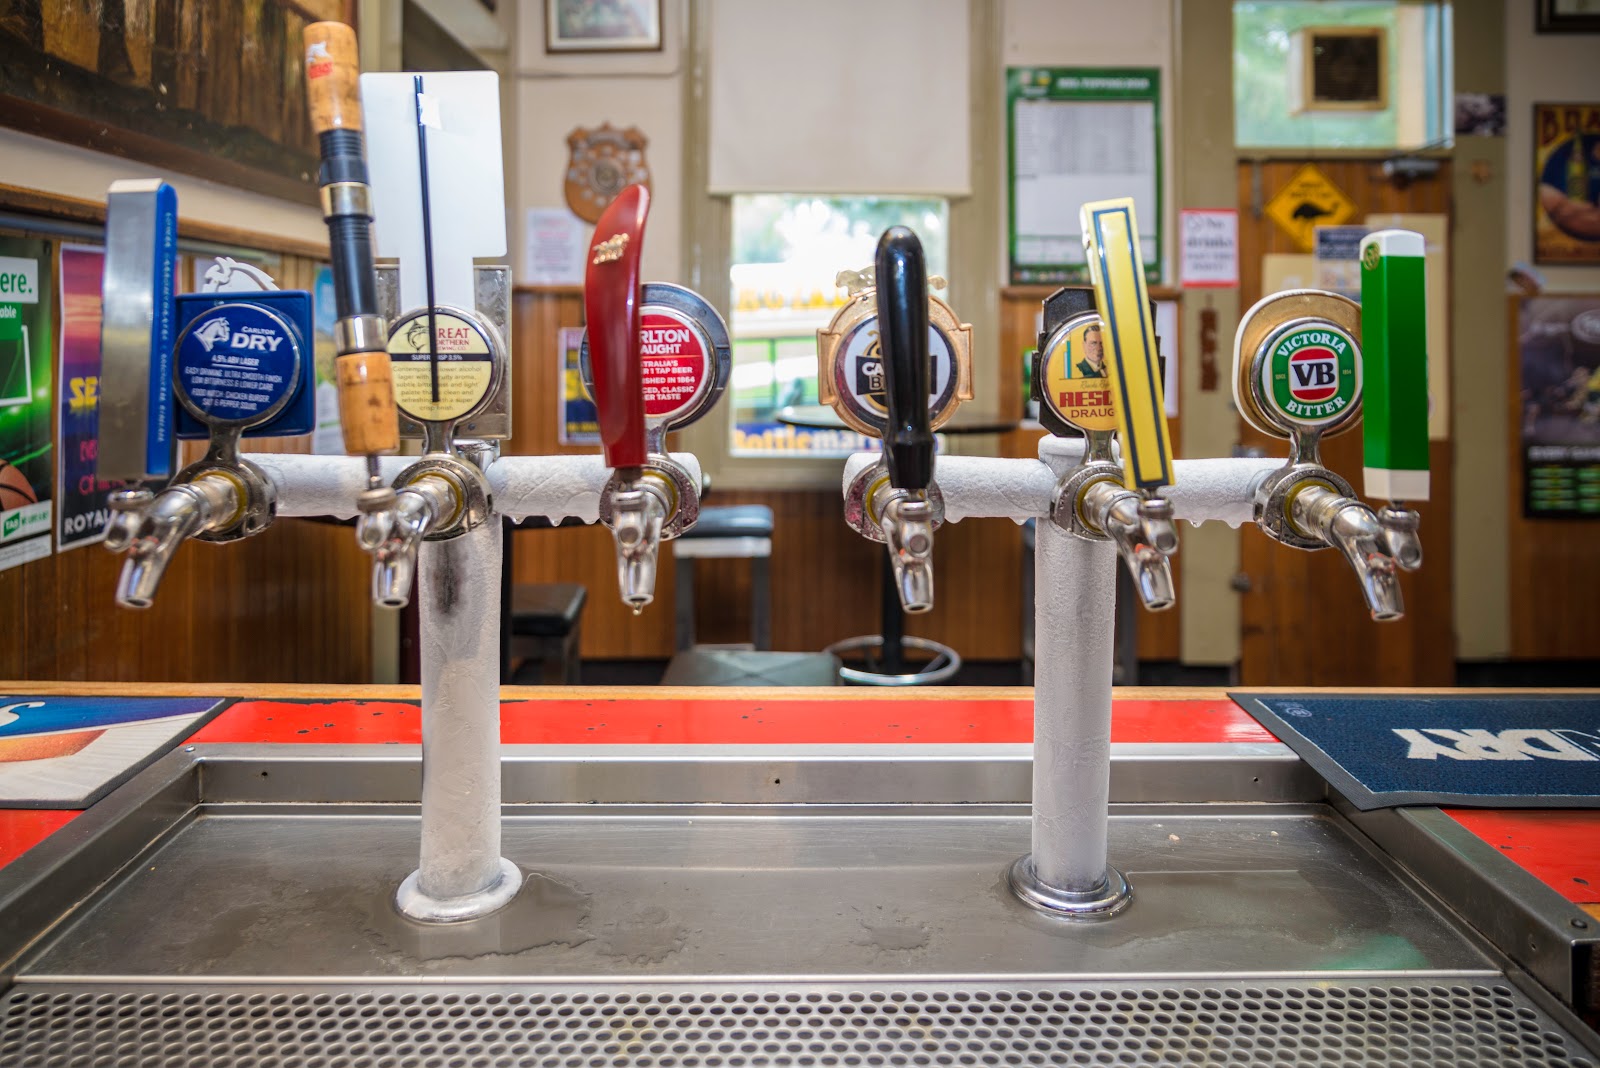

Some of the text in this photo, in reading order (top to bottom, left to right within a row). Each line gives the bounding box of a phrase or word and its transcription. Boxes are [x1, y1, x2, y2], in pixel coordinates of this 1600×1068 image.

[0, 272, 32, 294] ere.
[241, 326, 275, 335] CARLTON
[438, 328, 469, 338] REAT
[639, 329, 690, 343] RLTON
[230, 332, 283, 352] DRY
[1277, 332, 1347, 357] VICTORIA
[640, 344, 681, 355] AUGHT
[240, 358, 259, 366] LAGER
[642, 360, 679, 368] TRALIA'S
[671, 366, 693, 374] BEER
[1291, 362, 1336, 387] VB
[677, 376, 696, 384] 1864
[660, 385, 695, 394] CLASSIC
[656, 393, 681, 401] TASTE
[1060, 390, 1113, 408] RESC
[1285, 396, 1346, 416] BITTER
[1071, 408, 1115, 418] DRAUG
[6, 518, 19, 531] TAB
[1391, 728, 1600, 761] DRY
